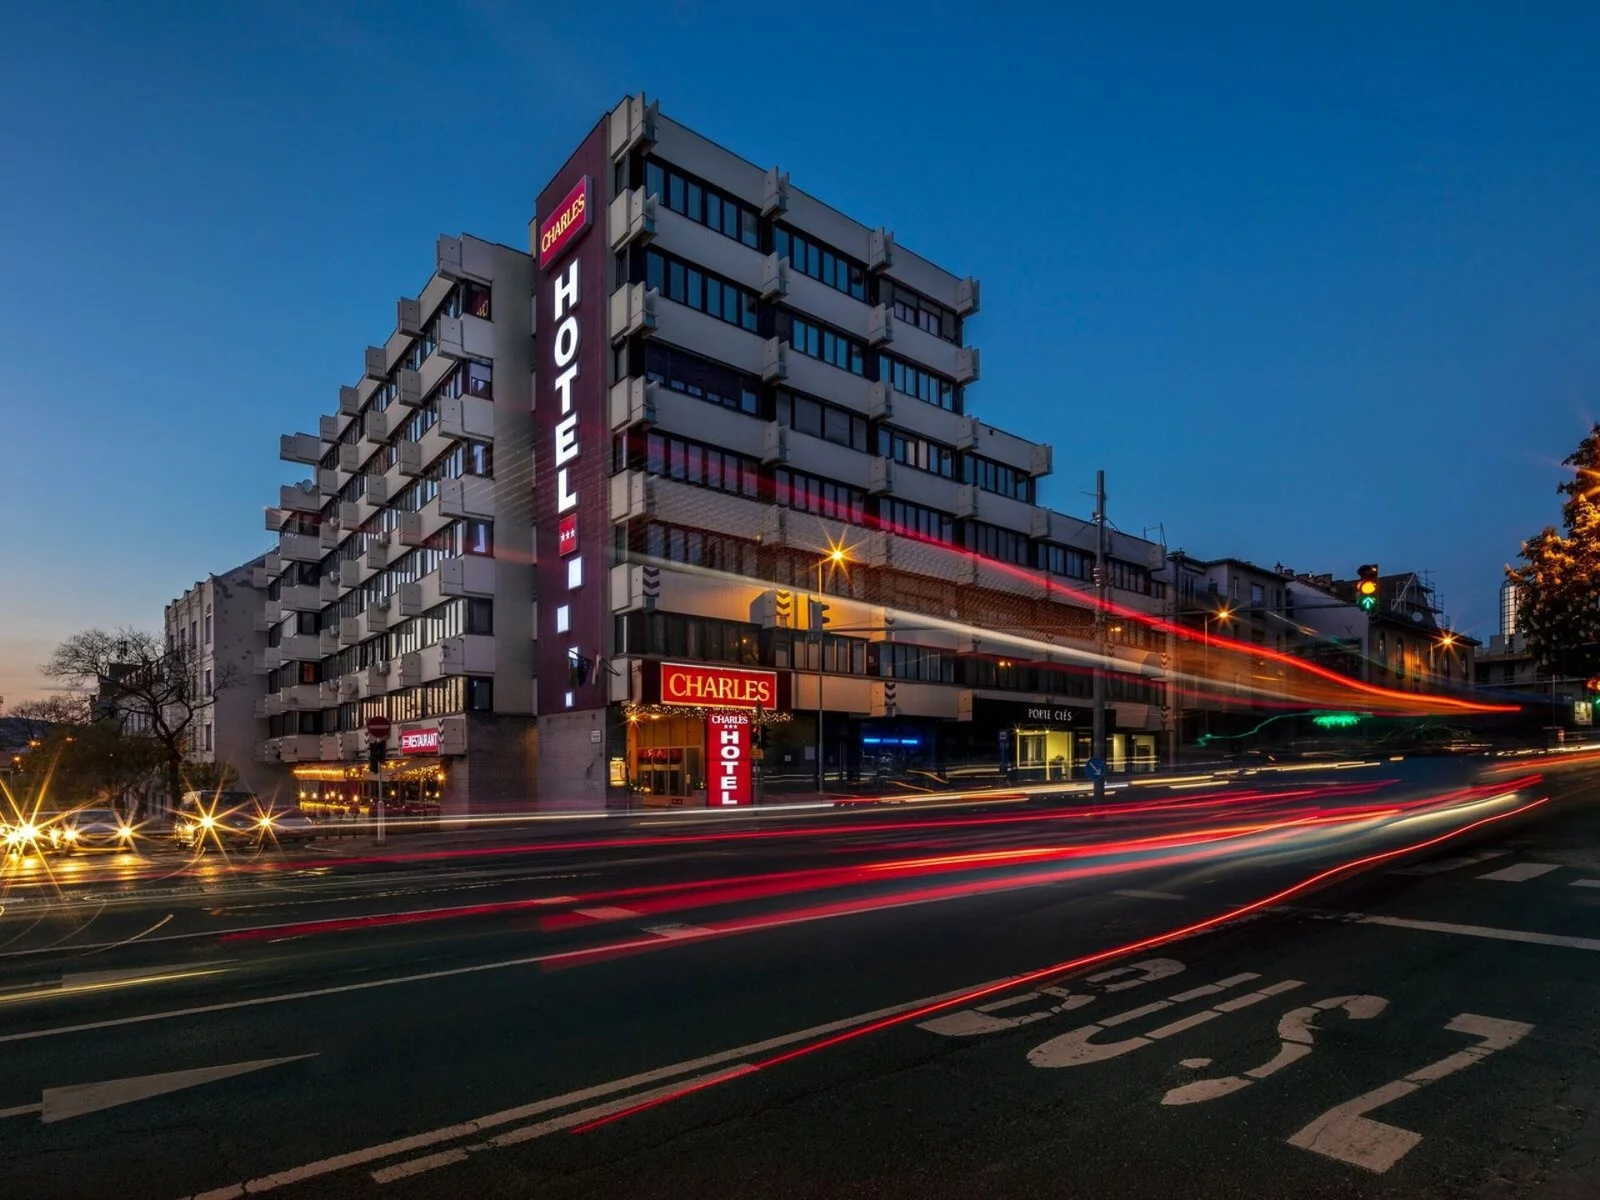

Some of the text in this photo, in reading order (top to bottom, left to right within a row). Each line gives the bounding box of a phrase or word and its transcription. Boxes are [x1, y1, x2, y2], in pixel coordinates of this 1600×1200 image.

[541, 193, 585, 252] CHARLES
[554, 258, 578, 513] HOTEL
[669, 673, 770, 702] CHARLES
[409, 733, 437, 748] RESTAURANT
[711, 714, 748, 724] CHARLES
[720, 730, 741, 805] HOTEL
[915, 957, 1537, 1175] BUSZ
